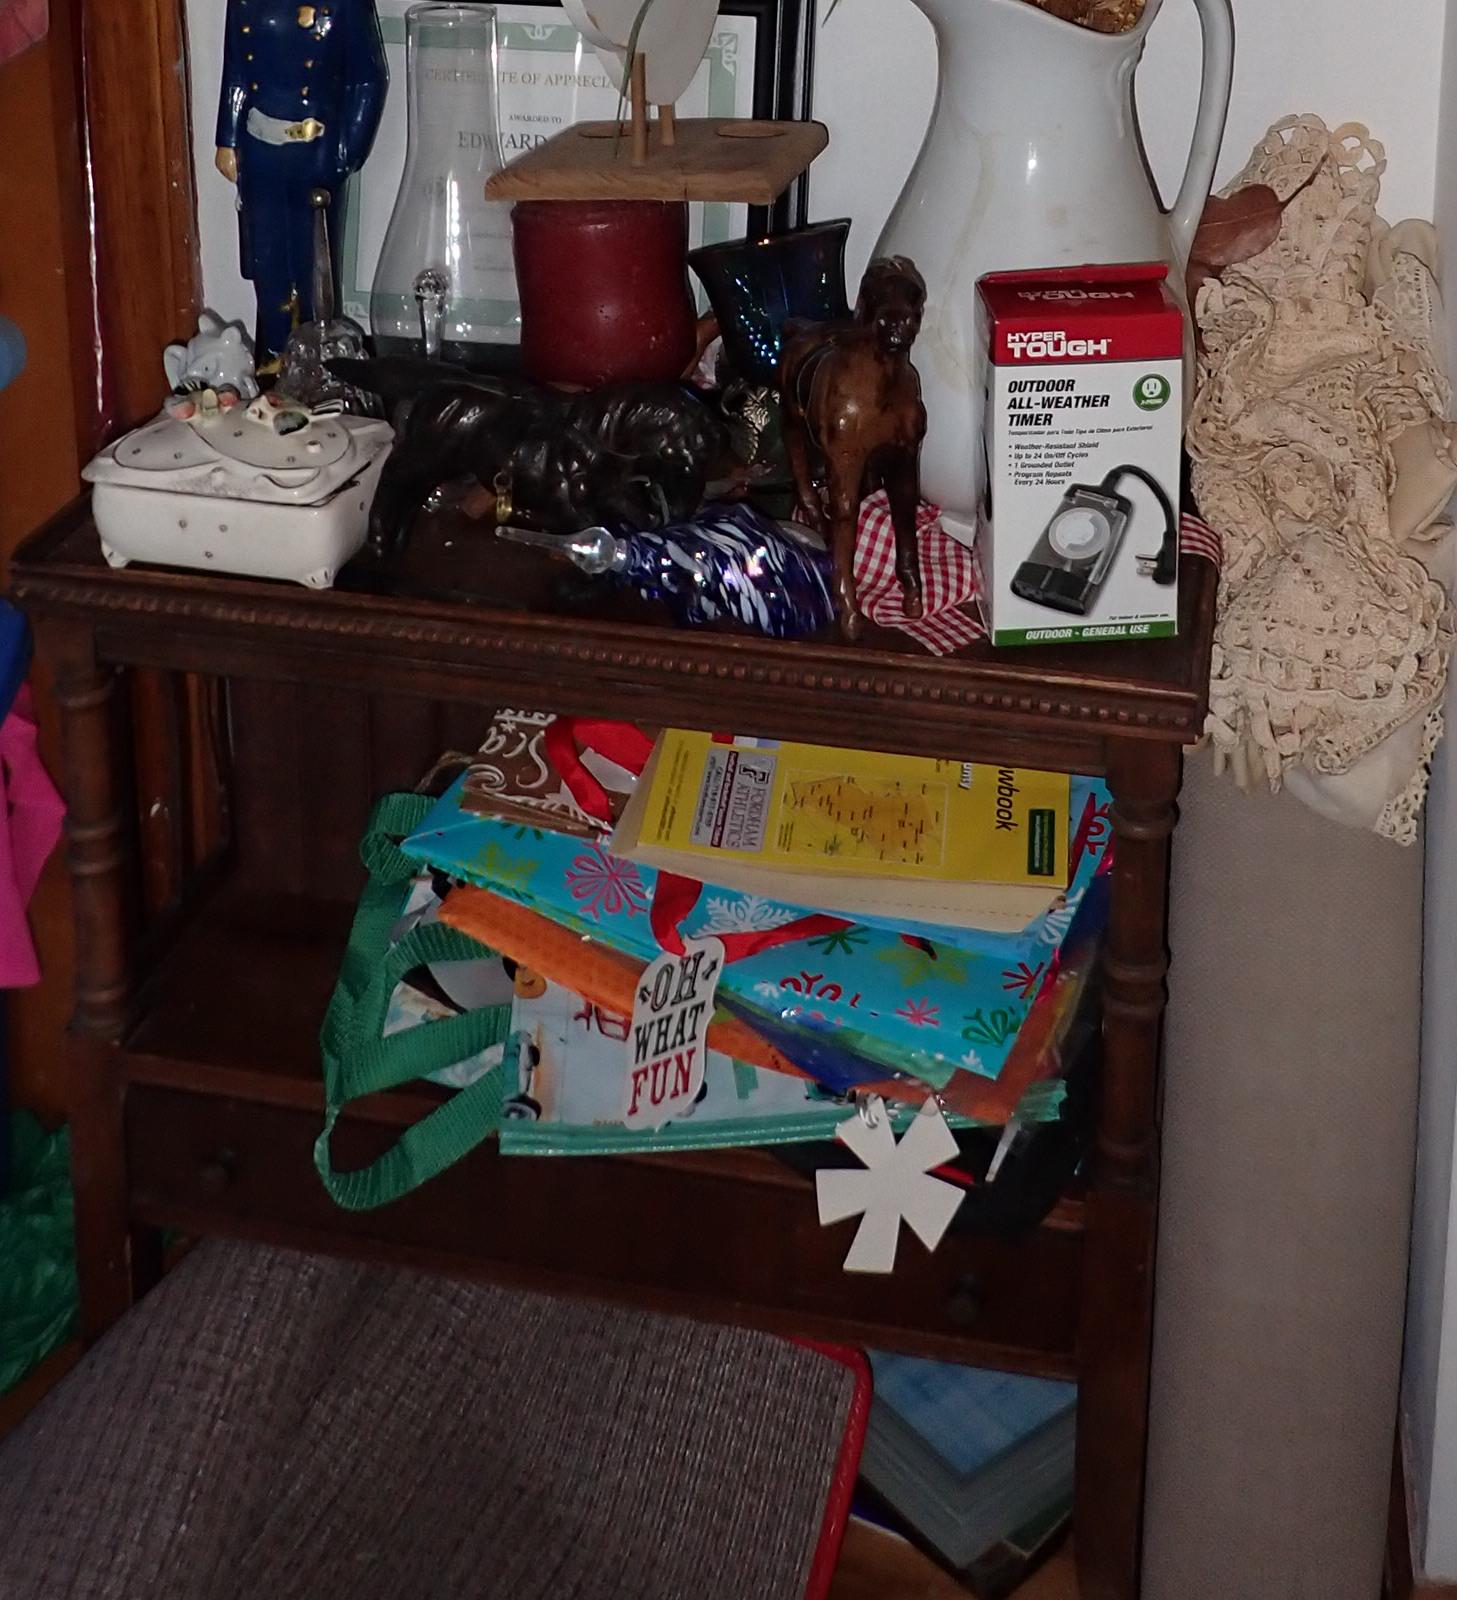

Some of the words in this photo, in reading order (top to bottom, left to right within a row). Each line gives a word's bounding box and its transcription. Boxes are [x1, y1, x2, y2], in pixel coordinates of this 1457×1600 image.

[426, 68, 517, 84] CERTIFITE
[521, 72, 541, 85] OF
[509, 114, 549, 123] AWARDED
[1007, 331, 1066, 342] HYPER
[1007, 339, 1108, 358] TOUGH
[1007, 379, 1076, 393] OUTDOOR
[1007, 394, 1110, 410] ALL-WEATHER
[1008, 413, 1053, 427] TIMER
[1067, 451, 1088, 459] Cycles
[1045, 470, 1072, 478] Repeats
[1026, 628, 1072, 640] OUTDOOR
[1082, 625, 1127, 637] GENERAL
[1129, 624, 1150, 634] USE
[726, 781, 750, 848] ATHLETICS
[742, 787, 765, 847] FORDHAM
[651, 950, 705, 1012] OH
[634, 1001, 706, 1064] WHAT
[627, 1047, 697, 1116] FUN
